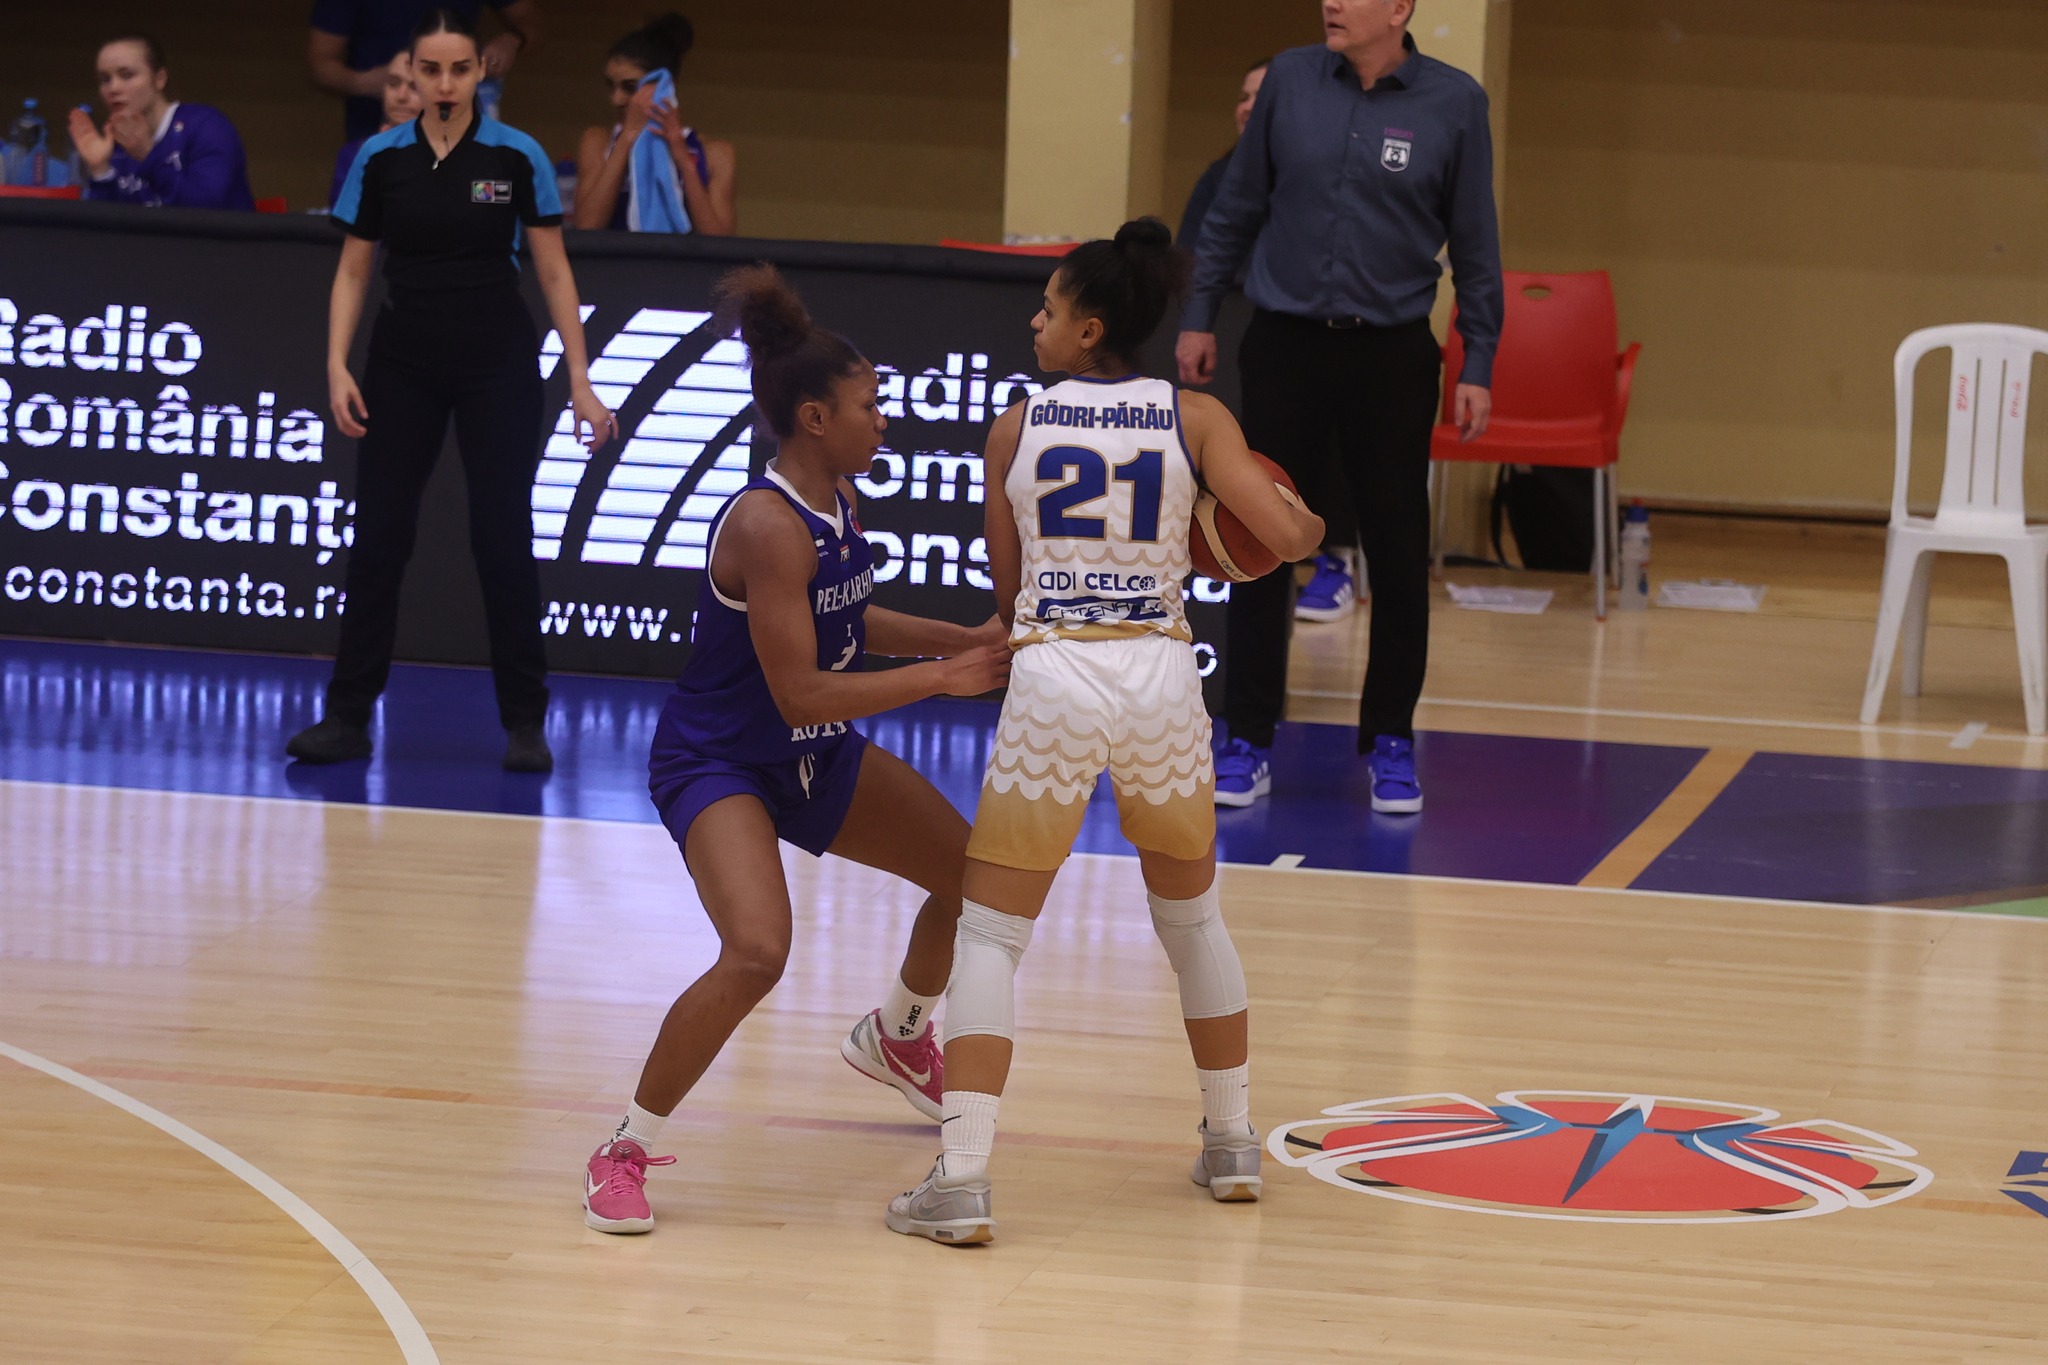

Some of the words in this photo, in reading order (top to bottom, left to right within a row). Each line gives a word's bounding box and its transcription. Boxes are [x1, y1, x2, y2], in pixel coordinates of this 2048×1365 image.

[0, 378, 325, 463] omânia
[1030, 399, 1174, 431] GÖDRI-PĂRĂU
[0, 461, 357, 566] onstanț
[1034, 443, 1166, 544] 21
[905, 1004, 922, 1027] CRAFT
